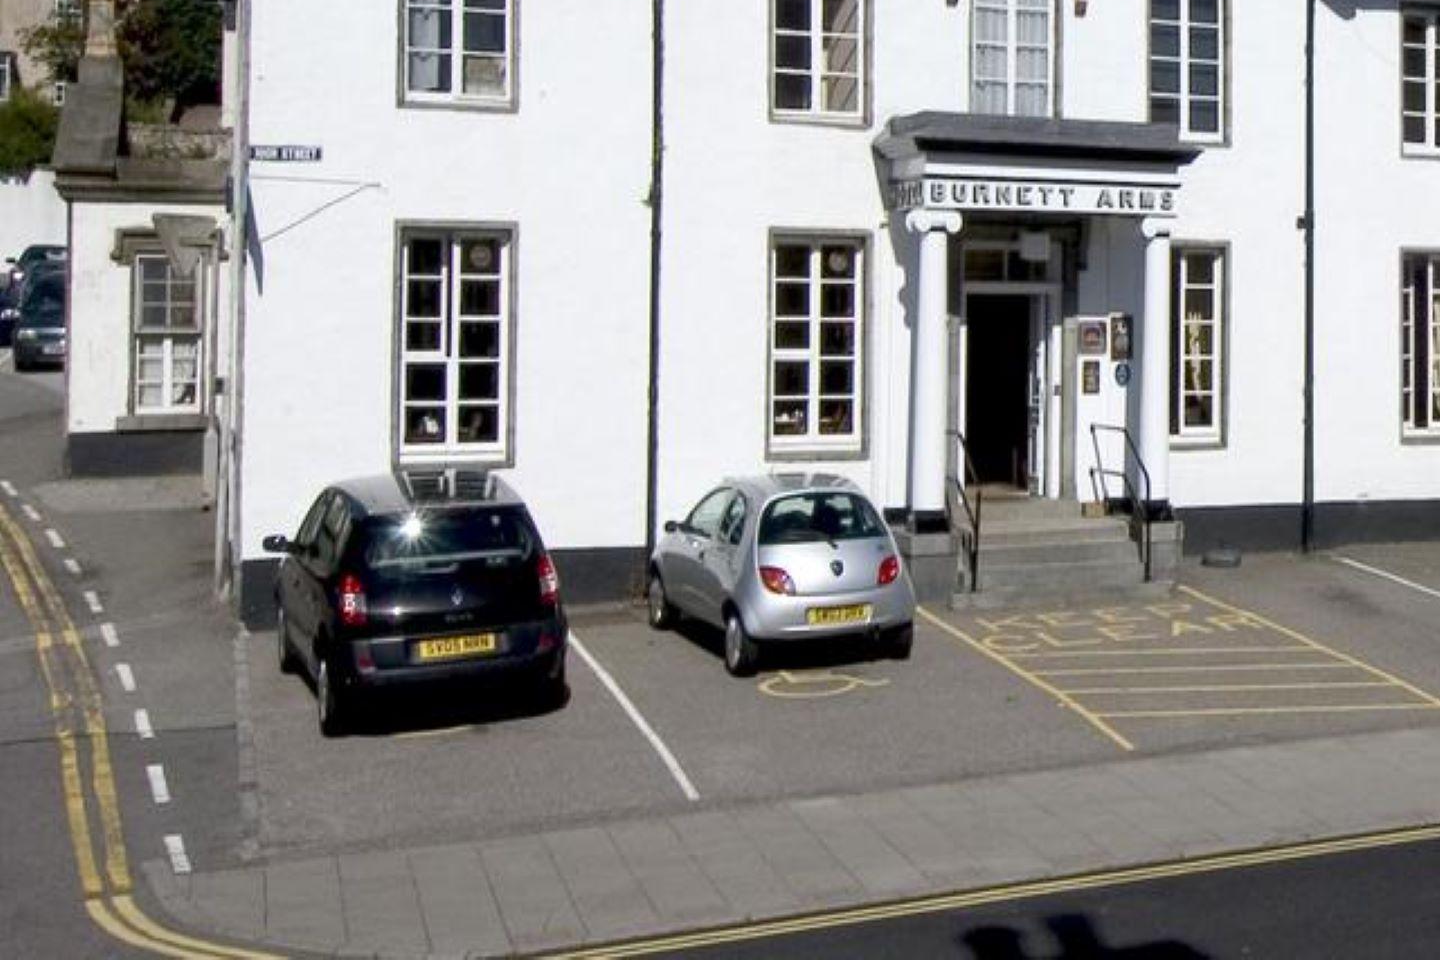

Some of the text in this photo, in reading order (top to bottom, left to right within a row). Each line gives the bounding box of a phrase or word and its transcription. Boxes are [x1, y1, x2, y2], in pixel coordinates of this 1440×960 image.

[930, 181, 1076, 208] BURNETT
[1096, 188, 1173, 212] ARMS
[980, 613, 1266, 653] CLEAR
